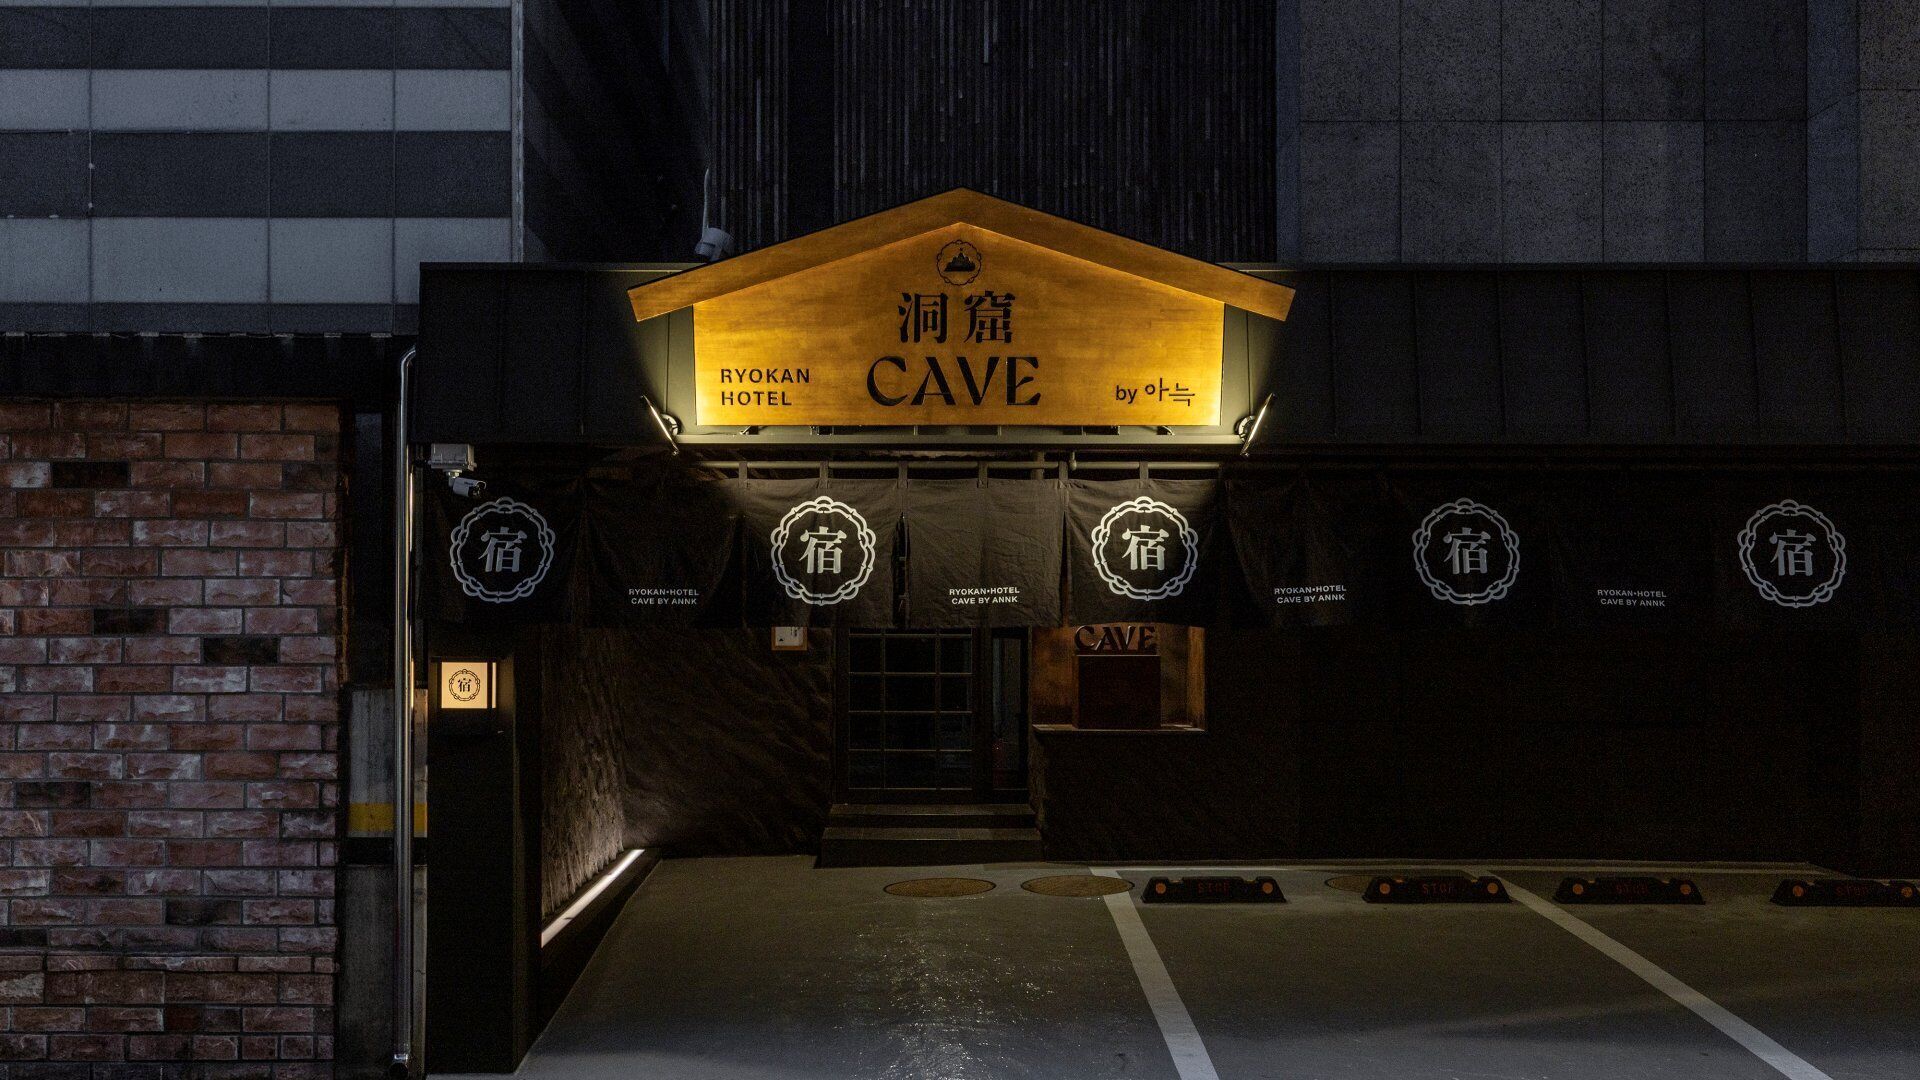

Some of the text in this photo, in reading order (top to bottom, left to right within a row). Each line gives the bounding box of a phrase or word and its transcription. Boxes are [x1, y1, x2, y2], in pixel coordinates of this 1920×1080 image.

[898, 290, 1016, 344] 洞窟
[720, 368, 810, 384] RYOKAN
[866, 356, 1041, 407] CAVE
[721, 391, 792, 406] HOTEL
[1115, 377, 1195, 407] by 아늑
[480, 526, 528, 574] 宿
[798, 526, 847, 574] 宿
[1121, 525, 1168, 571] 宿
[1442, 526, 1491, 575] 宿
[1768, 528, 1817, 576] 宿
[631, 597, 655, 605] CAVE
[657, 597, 669, 605] BY
[951, 595, 1018, 605] CAVE BY ANNK
[1276, 593, 1345, 604] CAVE BY ANNK
[1600, 598, 1665, 607] CAVE BY ANNK
[1074, 625, 1157, 652] CAVE
